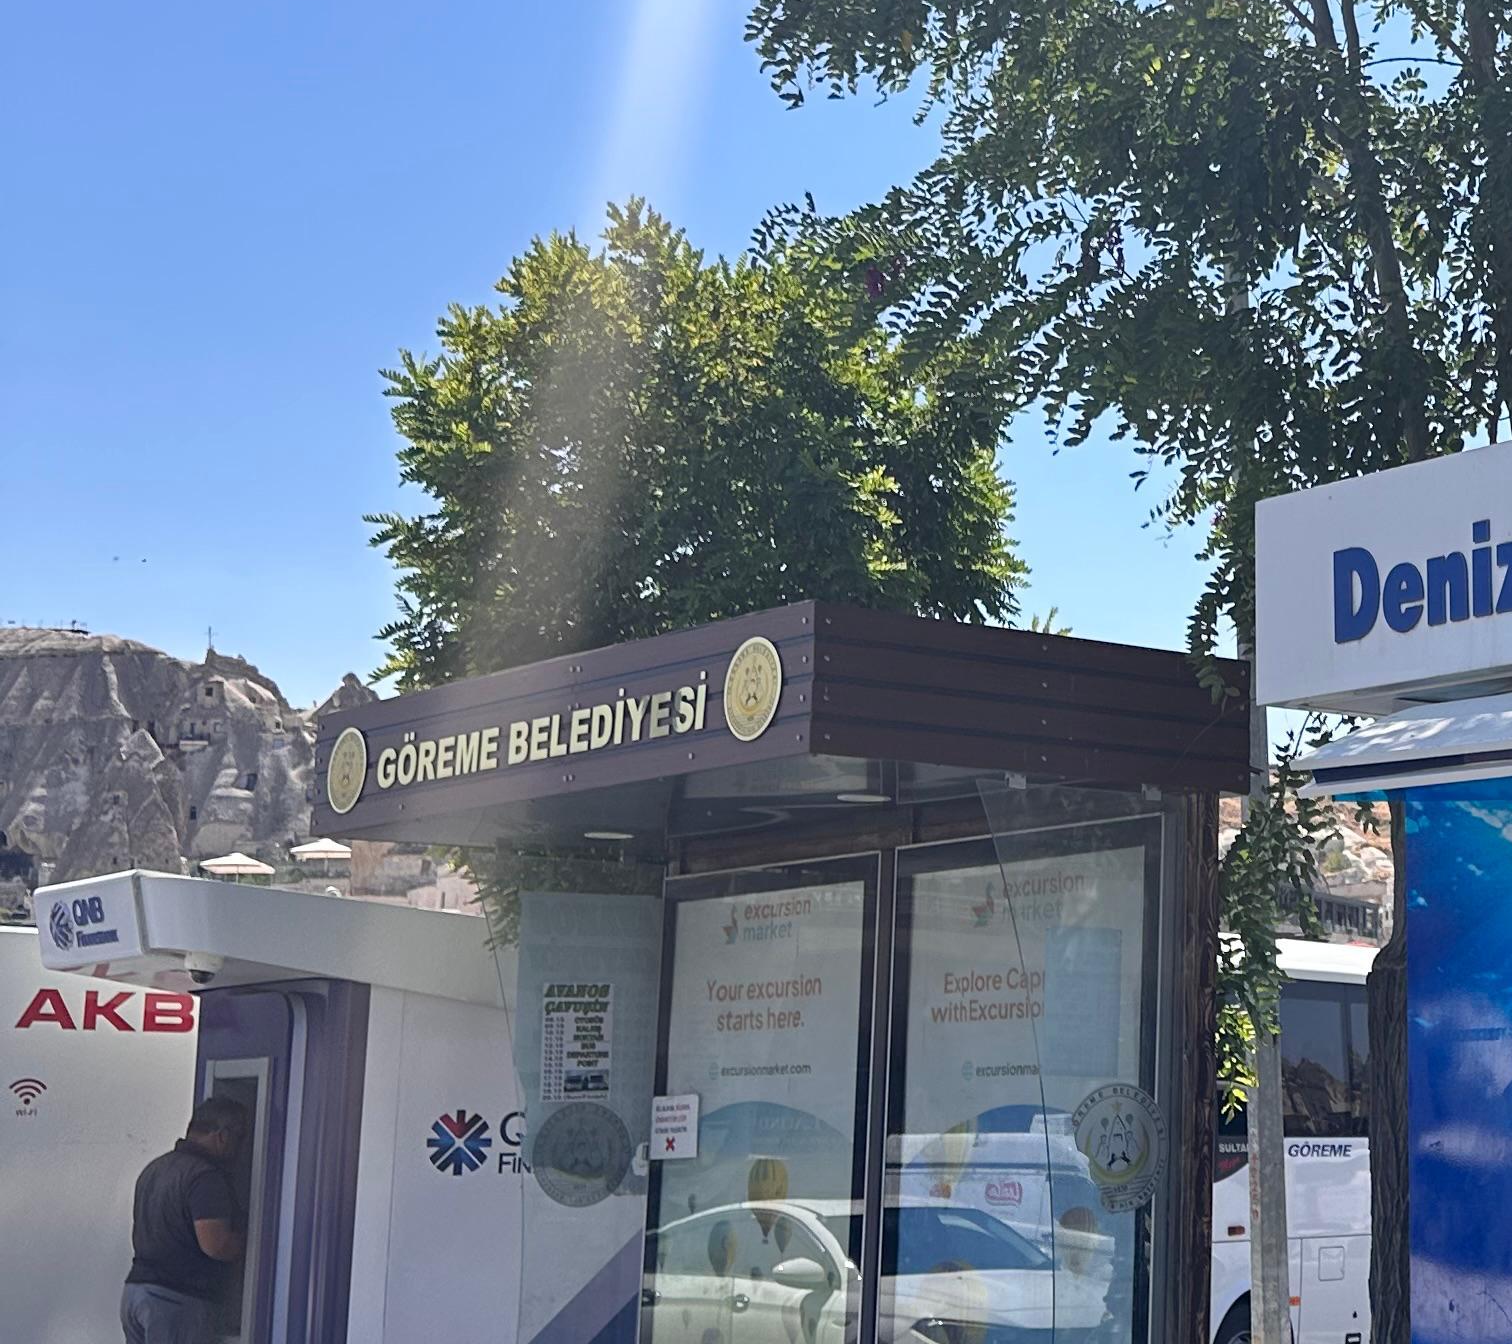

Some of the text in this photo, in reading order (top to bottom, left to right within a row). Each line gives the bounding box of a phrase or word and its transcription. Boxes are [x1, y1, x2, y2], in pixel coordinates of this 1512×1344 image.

[376, 726, 499, 789] GÖREME
[508, 671, 707, 766] BELEDİYESİ
[1002, 871, 1084, 899] excursion
[744, 897, 811, 920] excursion
[743, 920, 792, 942] market
[707, 974, 822, 1001] Your excursion
[944, 971, 1002, 996] Explore
[15, 988, 194, 1033] AKB
[717, 1008, 804, 1032] starts here.
[721, 1063, 811, 1077] excursionmarket.com
[976, 1064, 1040, 1077] excursionma
[1288, 1141, 1353, 1157] GÖREME
